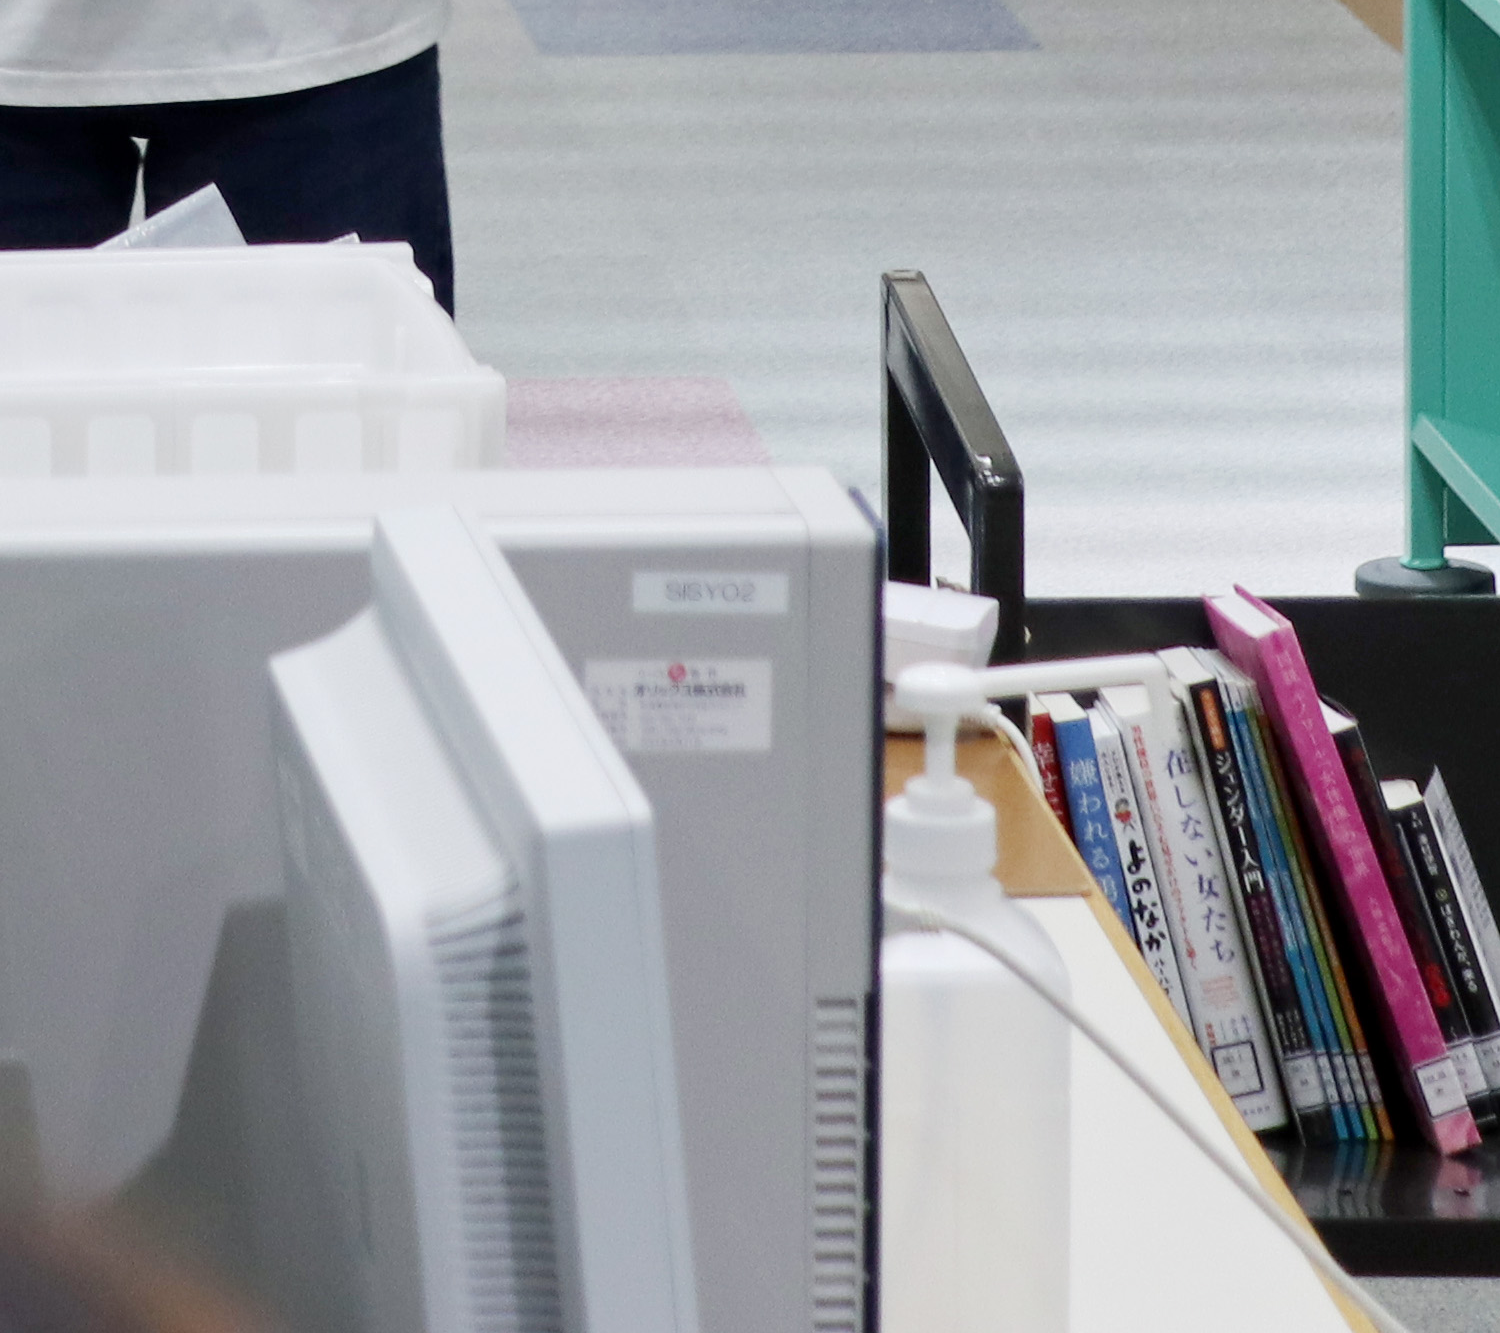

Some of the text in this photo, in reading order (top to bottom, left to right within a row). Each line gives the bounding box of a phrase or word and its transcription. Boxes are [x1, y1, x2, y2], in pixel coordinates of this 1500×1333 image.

[1214, 751, 1266, 894] ジェンダー入門
